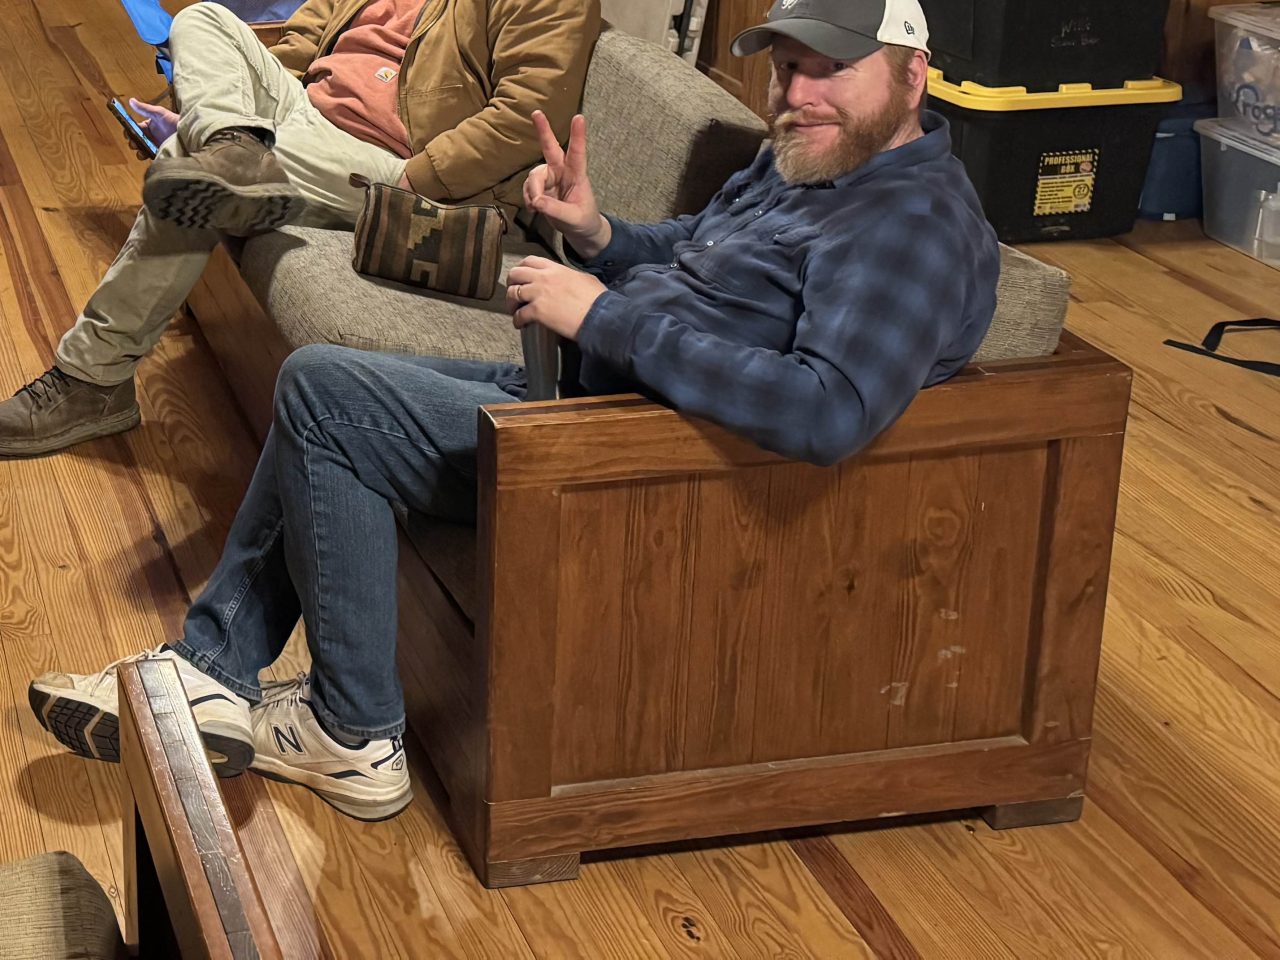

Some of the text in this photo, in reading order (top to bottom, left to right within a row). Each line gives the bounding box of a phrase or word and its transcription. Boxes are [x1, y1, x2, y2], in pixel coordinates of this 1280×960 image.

[1044, 154, 1093, 165] PROFESSIONAL
[1061, 164, 1075, 173] BOX
[272, 725, 304, 755] N
